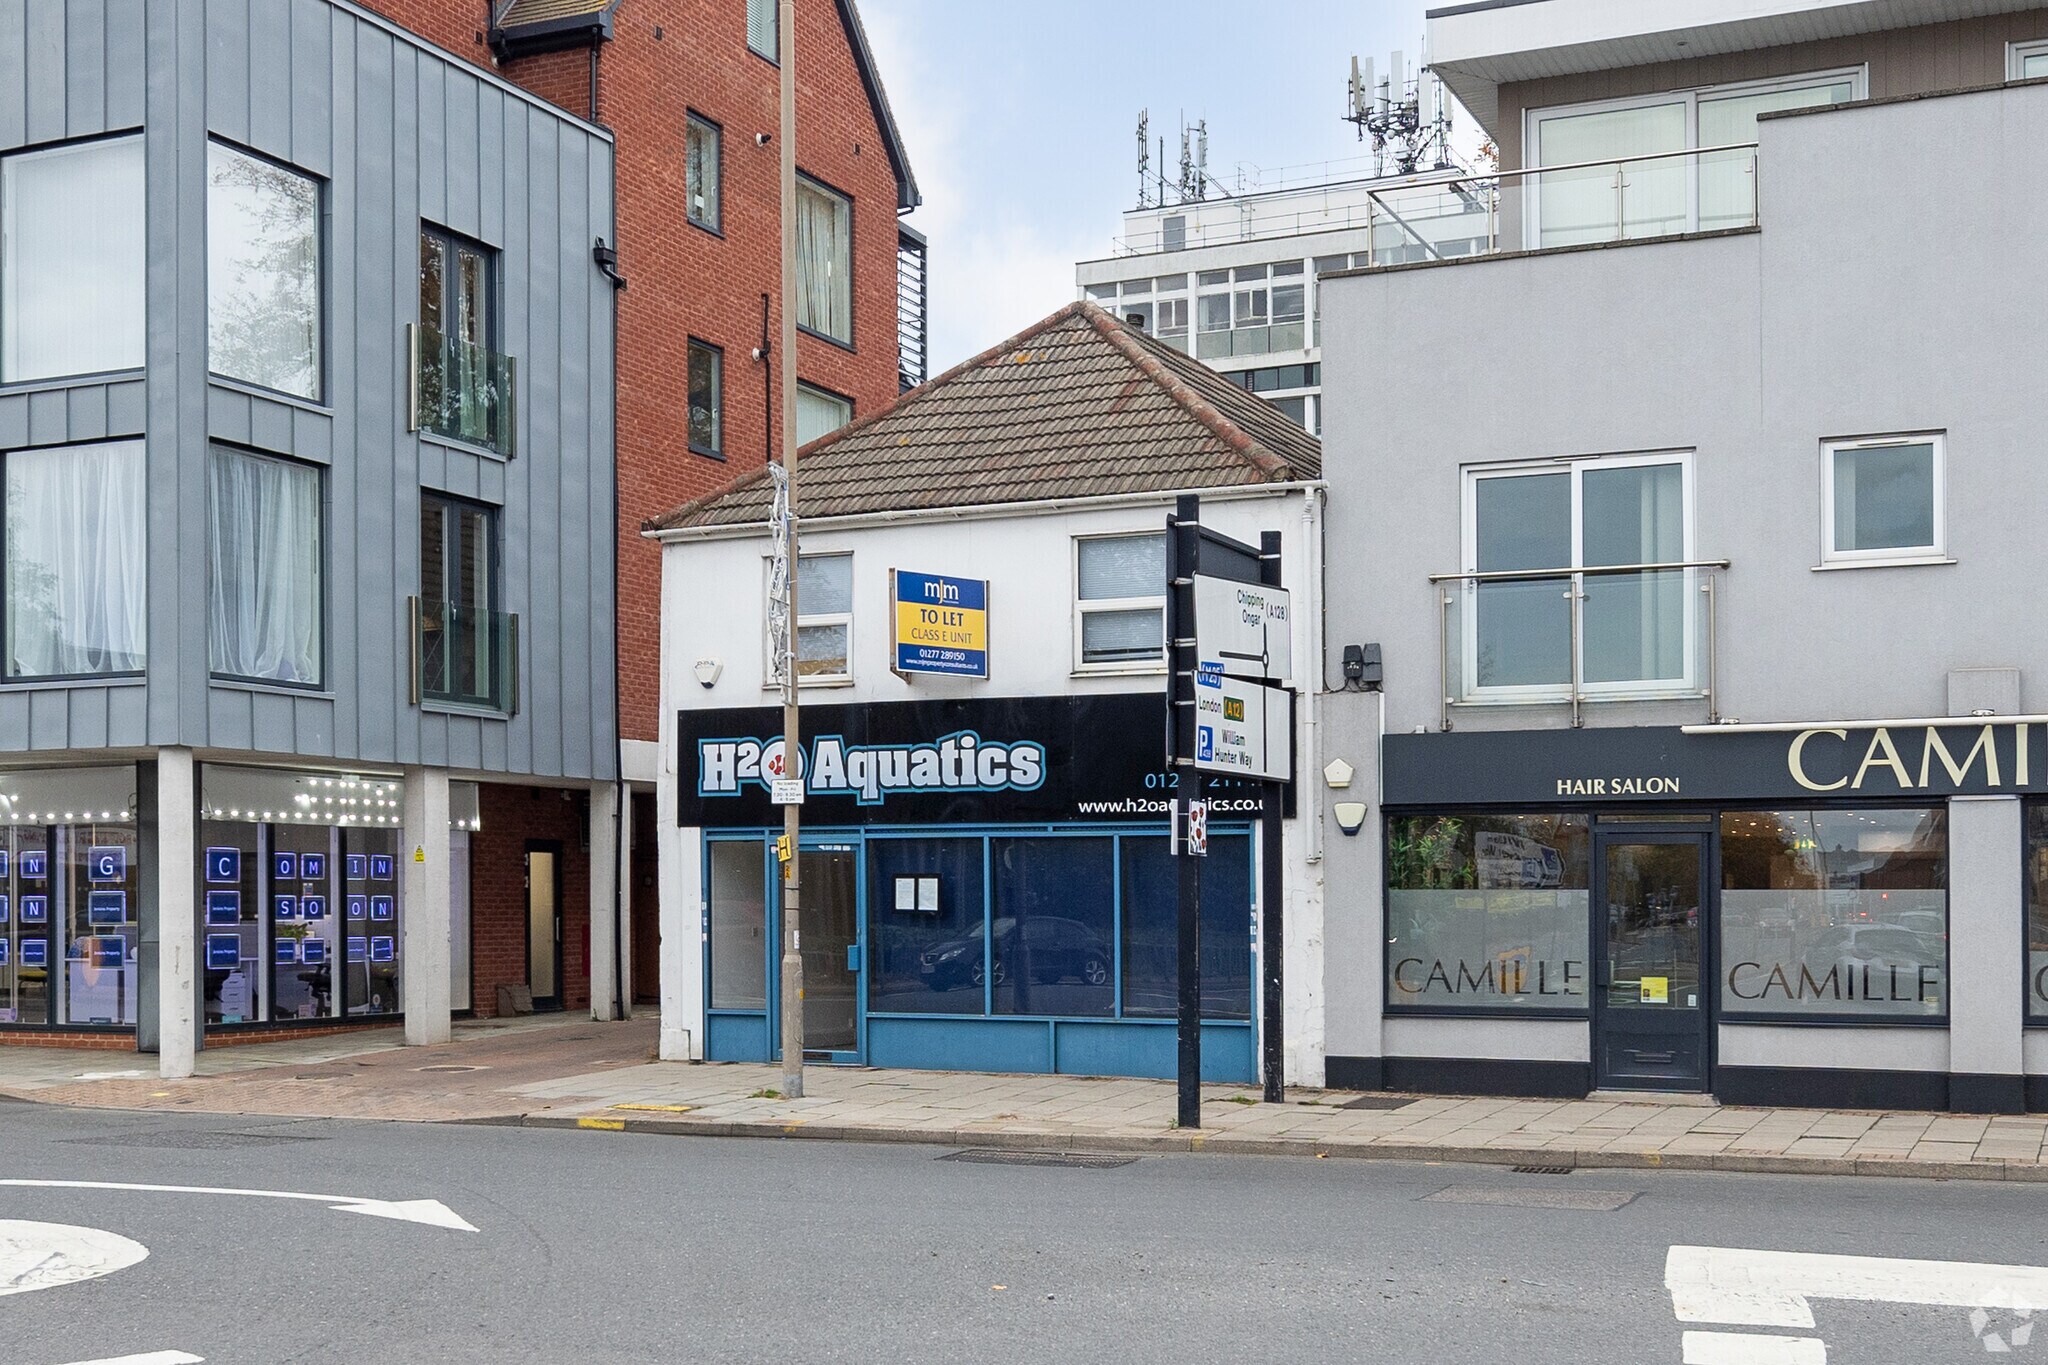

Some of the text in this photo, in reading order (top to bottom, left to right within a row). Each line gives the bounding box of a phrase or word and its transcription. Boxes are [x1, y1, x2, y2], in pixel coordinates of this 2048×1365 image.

[1237, 589, 1264, 610] Chipping
[920, 608, 964, 627] TO LET
[1242, 609, 1261, 627] Ongar
[1266, 602, 1288, 621] (A128)
[911, 627, 972, 644] CLASS E UNIT
[919, 648, 965, 661] 01277 289150
[1199, 695, 1244, 720] London (A12)
[1199, 729, 1209, 758] P
[1222, 729, 1246, 746] William
[811, 735, 1041, 799] Aquatics
[1214, 747, 1237, 764] Hunter
[1239, 750, 1253, 769] Way
[1787, 723, 2048, 791] CAMI
[1557, 777, 1679, 795] HAIR SALON
[778, 836, 791, 859] H
[1394, 957, 1583, 996] CAMILLE
[1727, 961, 1940, 1002] CAMILLE
